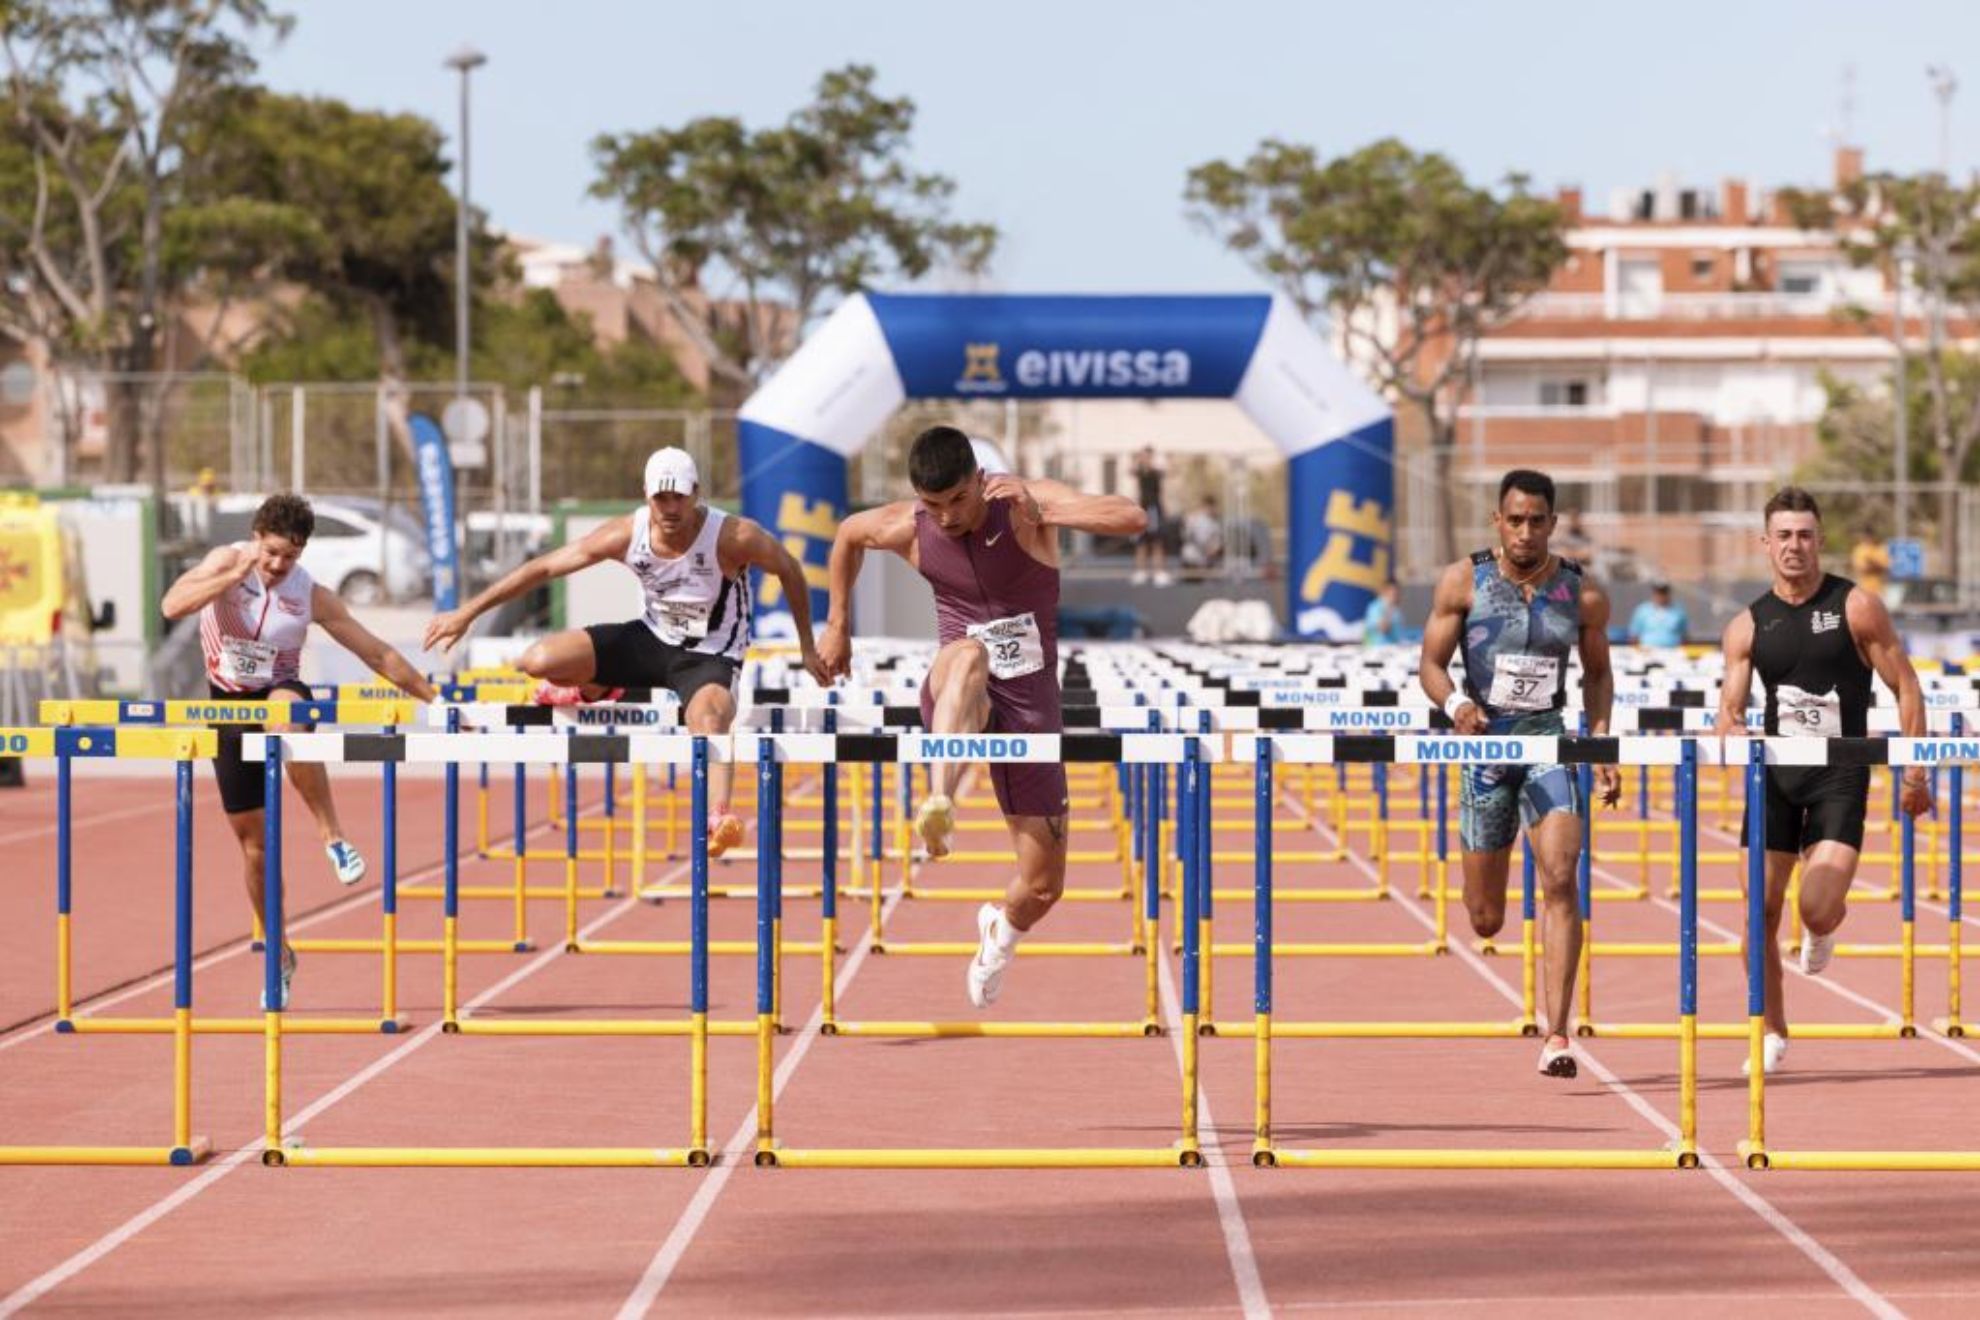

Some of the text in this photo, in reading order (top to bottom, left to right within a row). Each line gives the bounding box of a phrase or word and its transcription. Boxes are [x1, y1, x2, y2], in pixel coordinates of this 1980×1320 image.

[994, 640, 1021, 661] 32
[1512, 679, 1539, 697] 37
[1275, 693, 1340, 704] MONDO
[186, 706, 268, 721] MONDO
[577, 709, 660, 726] MONDO
[1330, 712, 1411, 727] MONDO
[921, 738, 1028, 758] MONDO
[1417, 740, 1523, 760] MONDO
